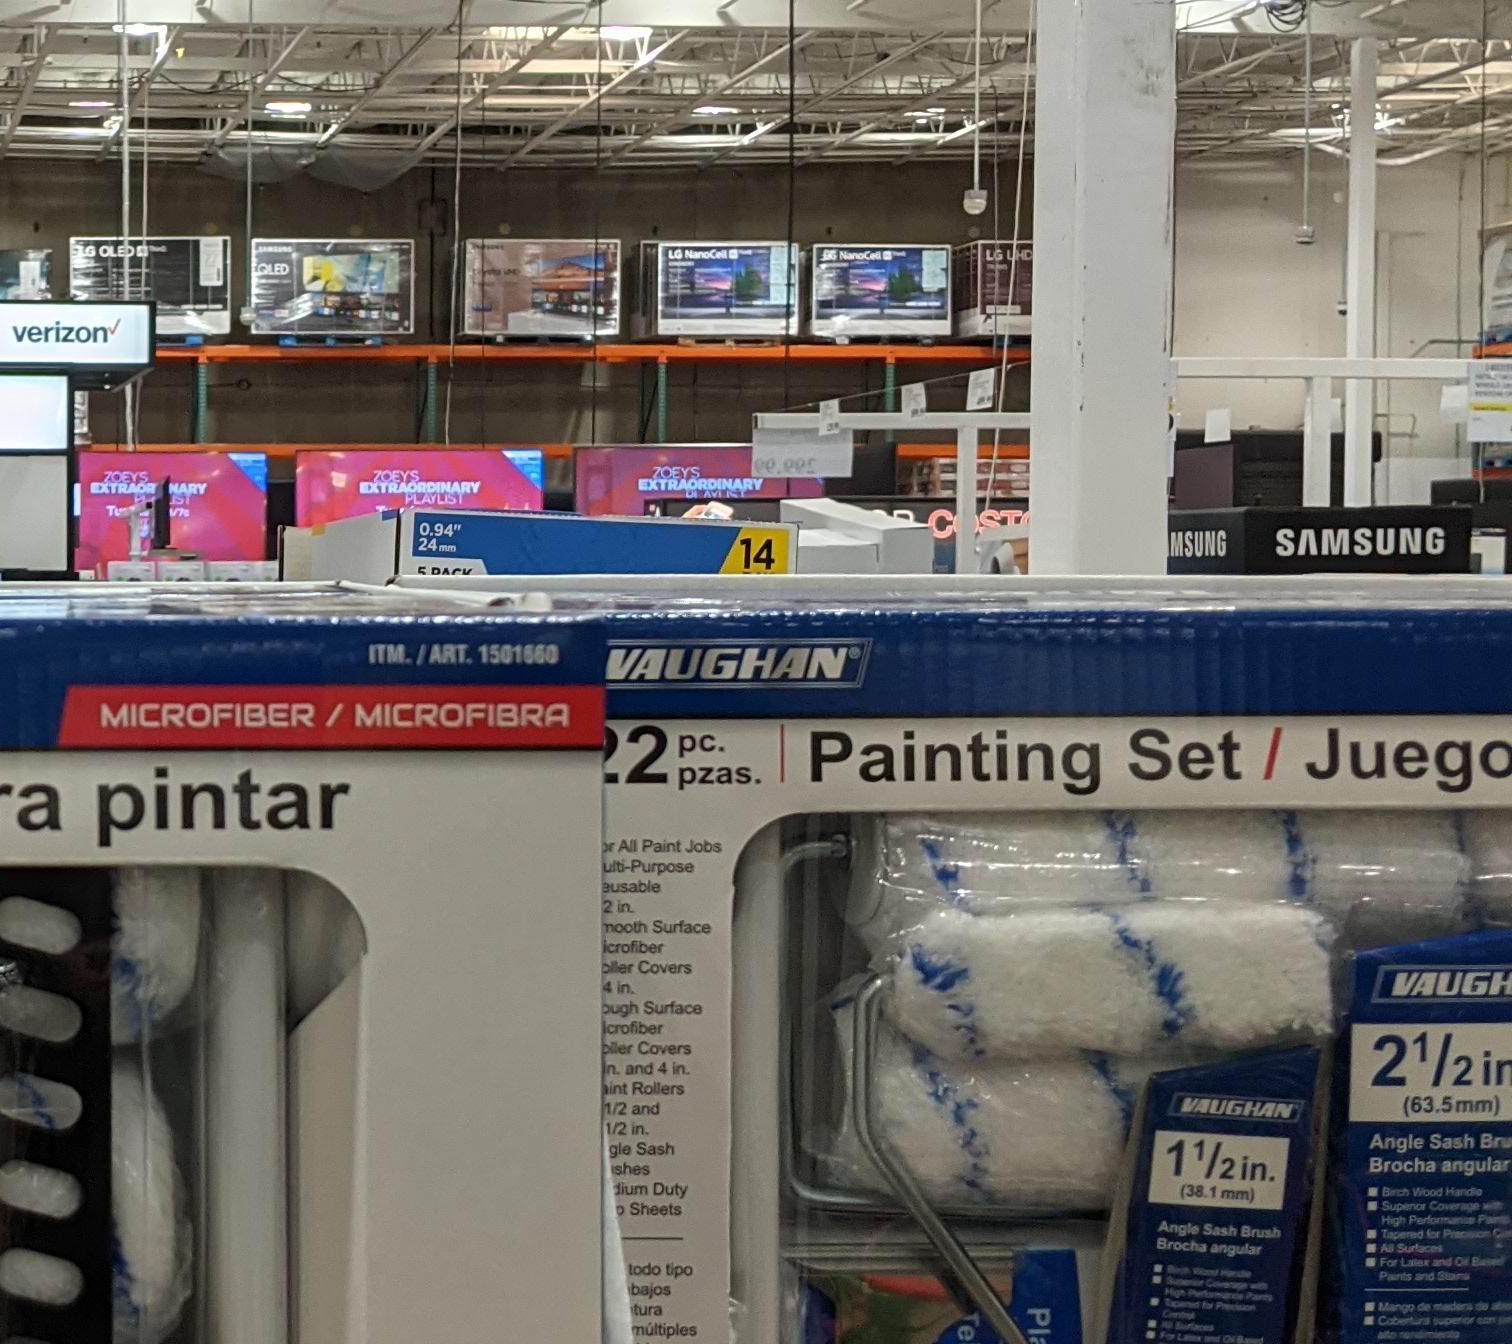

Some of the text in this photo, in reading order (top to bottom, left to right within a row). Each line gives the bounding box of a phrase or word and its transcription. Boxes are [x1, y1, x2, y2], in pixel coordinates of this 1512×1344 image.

[12, 321, 109, 344] verizon
[359, 482, 481, 495] EXTRAORDINARY
[638, 478, 763, 492] EXTRAORDINARY
[418, 538, 437, 553] 24
[1169, 527, 1445, 558] MSUNG SAMSUNG
[740, 537, 775, 571] 14
[369, 644, 410, 663] ITM.
[432, 644, 470, 663] ART.
[99, 702, 570, 729] MICROFIBER MICROFIBRA
[677, 735, 726, 759] pc.
[809, 728, 1512, 795] Painting Set Juego
[678, 763, 761, 791] pzas.
[97, 766, 350, 846] pintar
[642, 839, 722, 854] Paint Jobs
[652, 920, 712, 934] Surface
[638, 961, 692, 975] Covers
[1403, 1094, 1501, 1118] (63.5 mm)
[1369, 1133, 1475, 1153] Angle Sash
[1180, 1184, 1256, 1204] (38.1 mm)
[1156, 1236, 1262, 1258] Brocha angular
